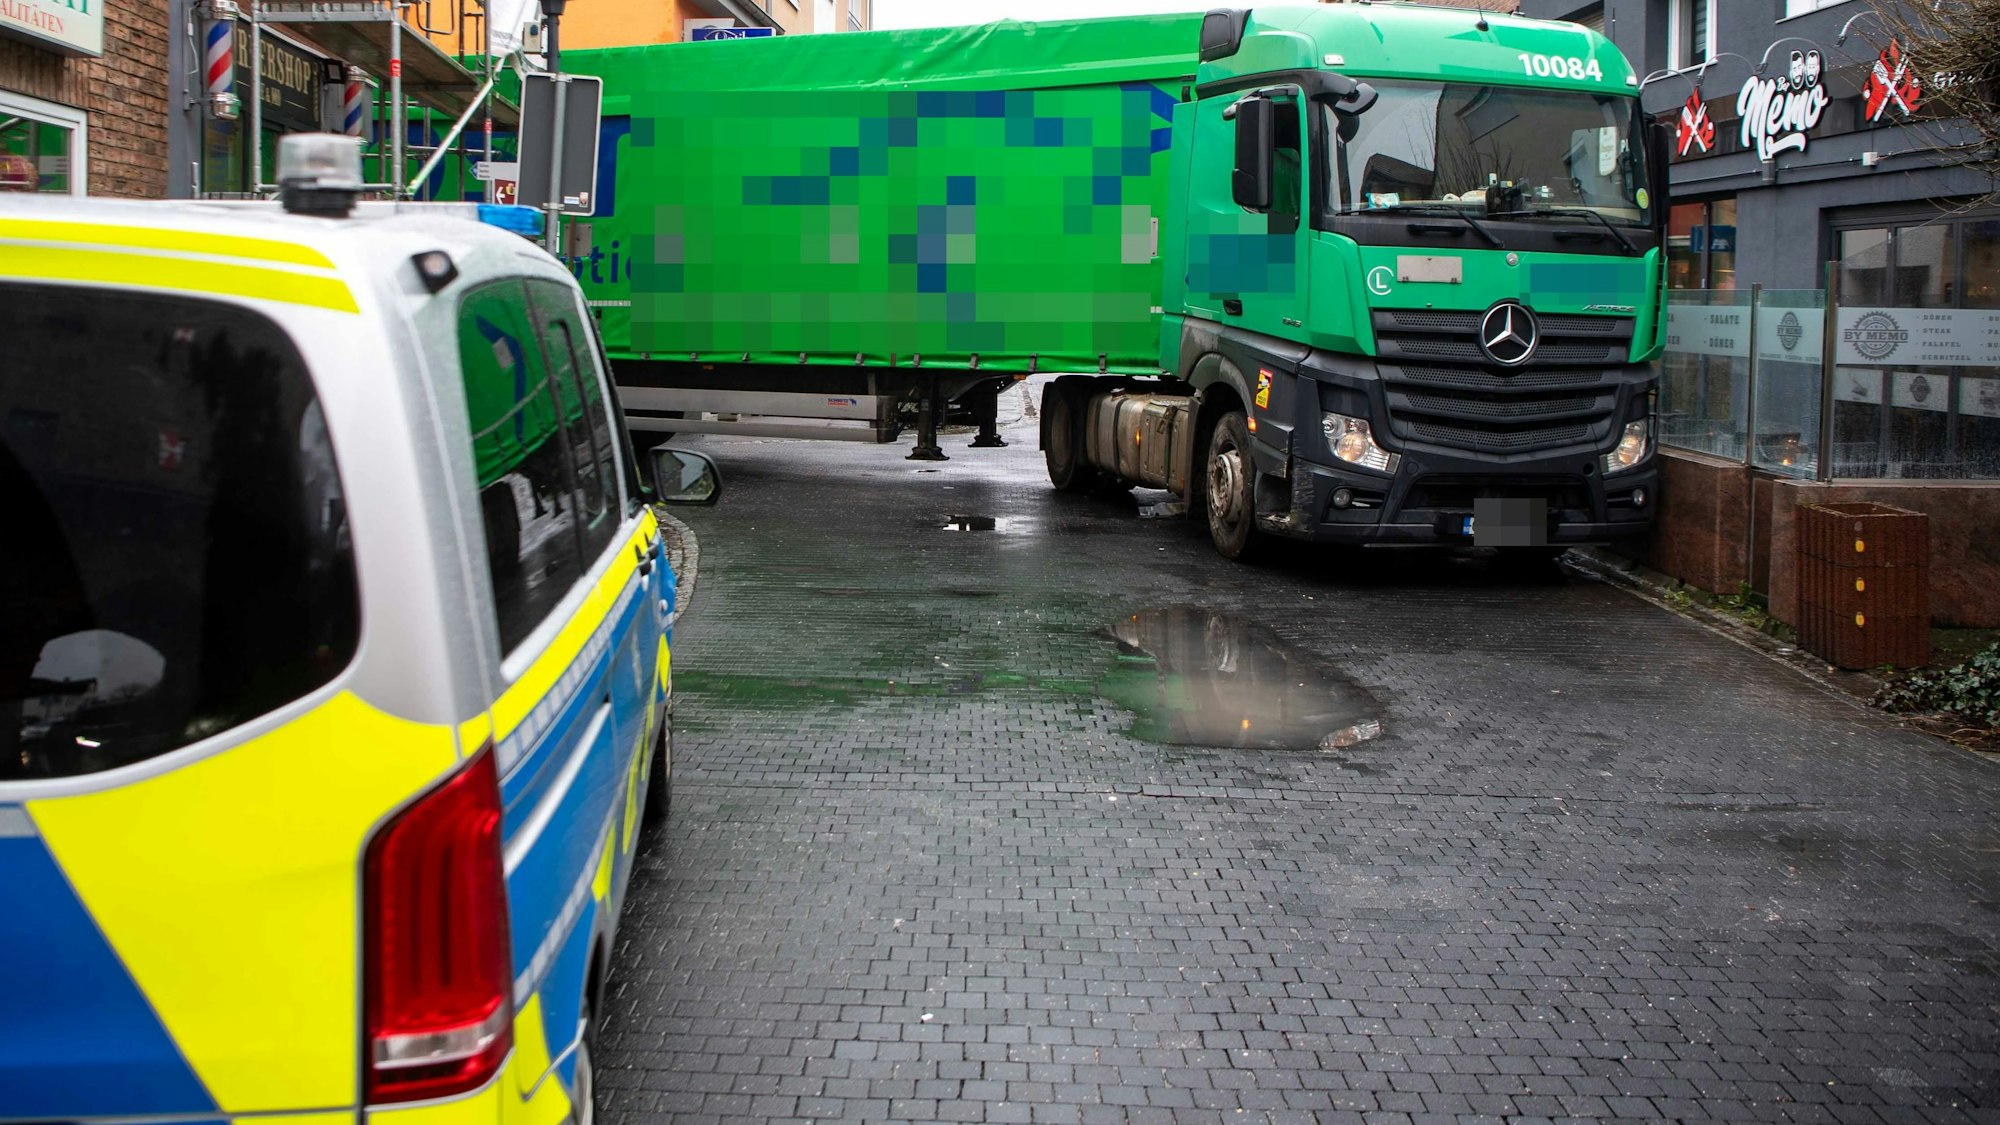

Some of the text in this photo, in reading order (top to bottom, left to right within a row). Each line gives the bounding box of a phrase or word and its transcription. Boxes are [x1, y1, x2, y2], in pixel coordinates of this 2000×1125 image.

[1518, 53, 1603, 81] 10084
[1736, 75, 1829, 161] Memo
[1710, 314, 1740, 325] SALATE
[1923, 313, 1953, 321] DÖNER
[1844, 331, 1909, 341] BY MEMO
[1709, 337, 1735, 349] DÖNER
